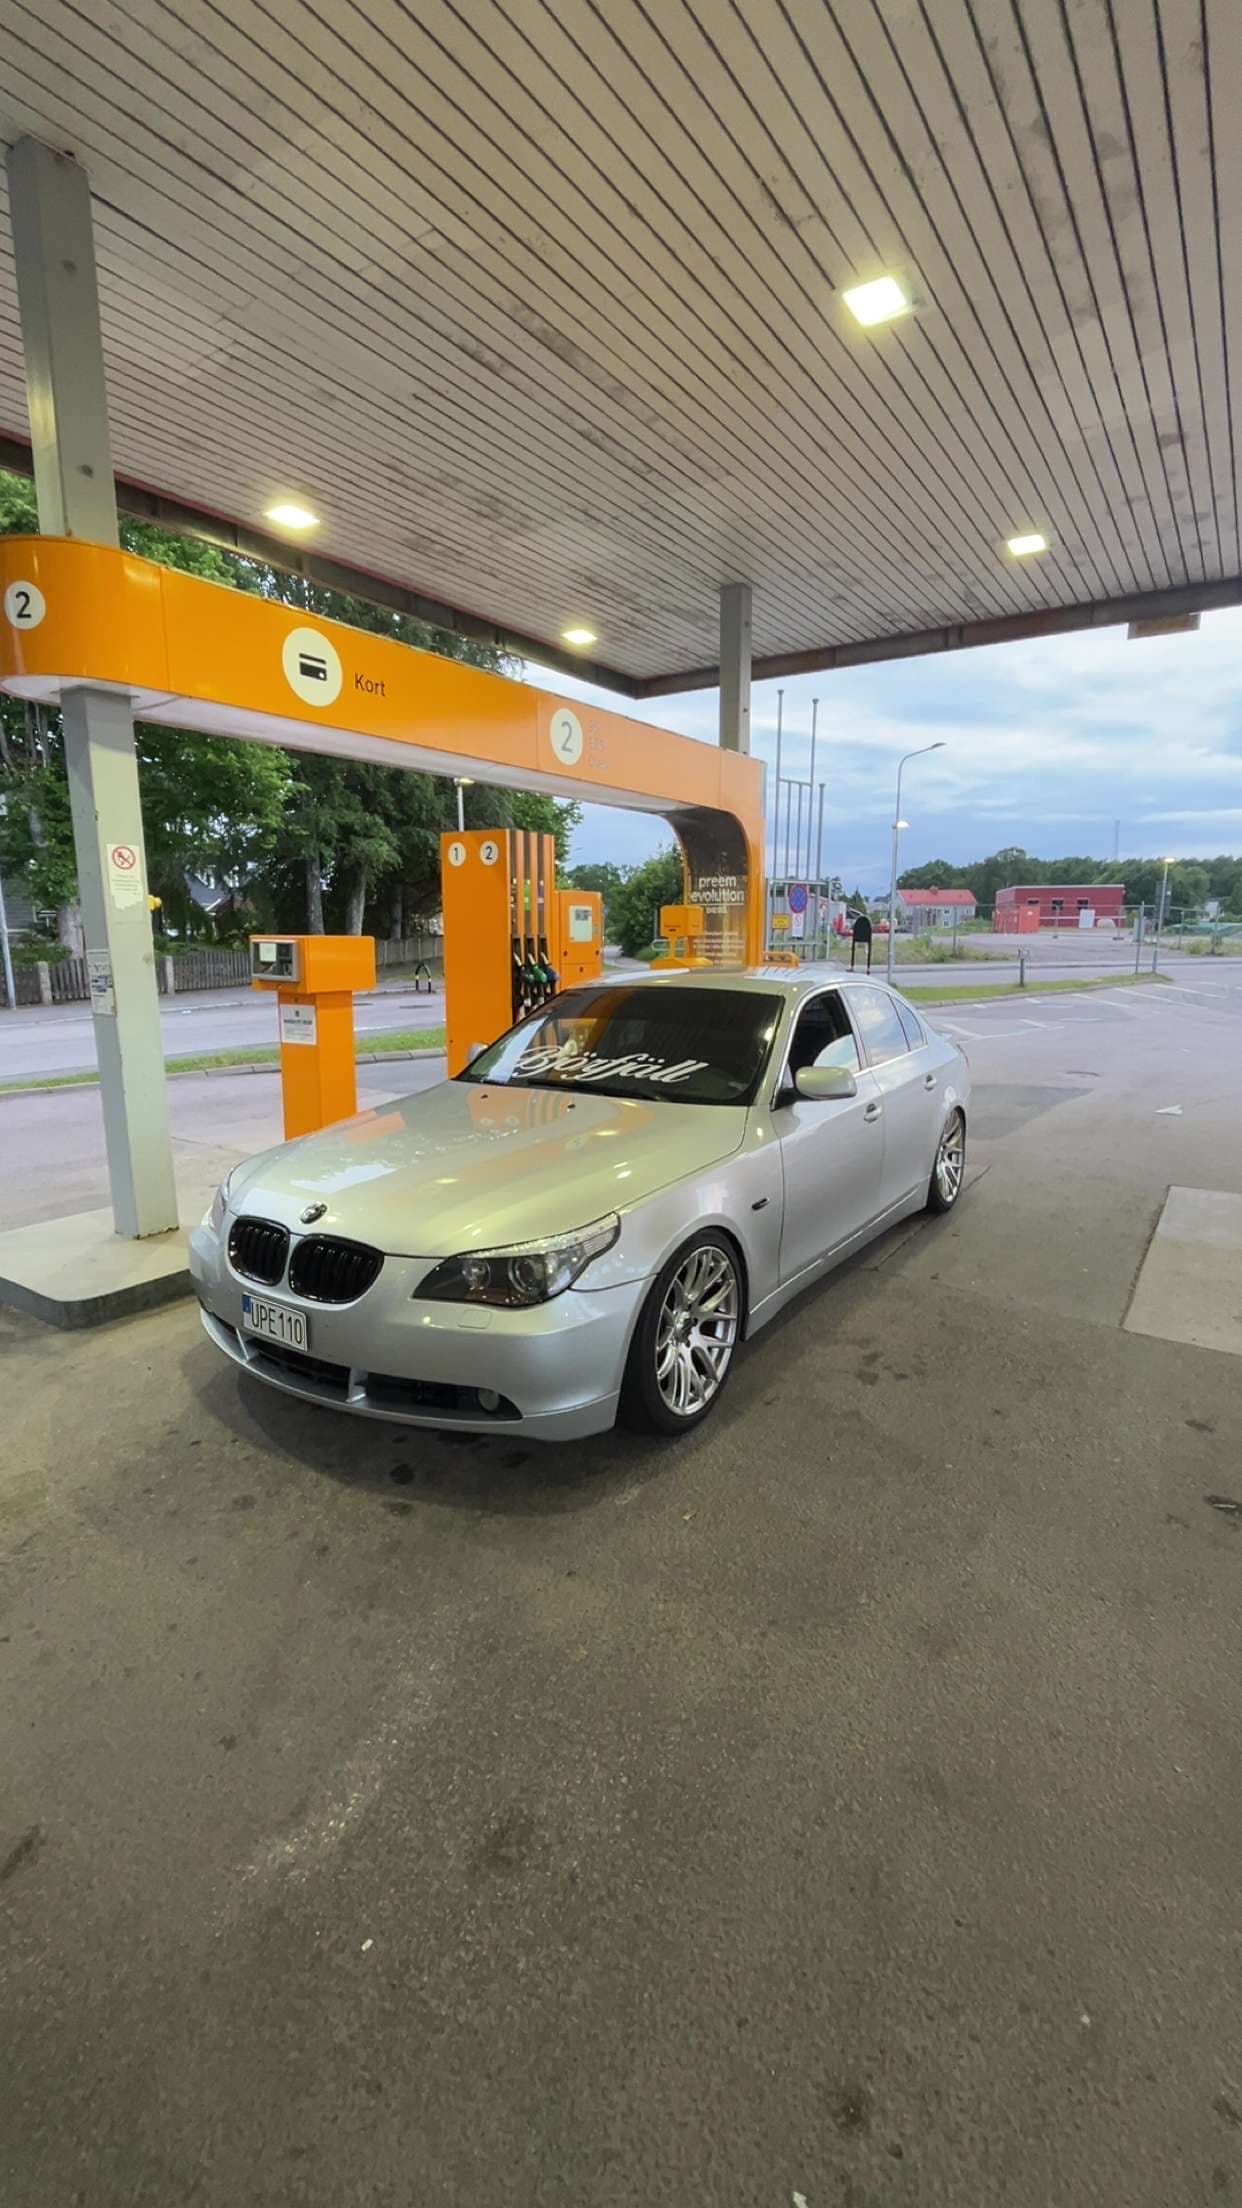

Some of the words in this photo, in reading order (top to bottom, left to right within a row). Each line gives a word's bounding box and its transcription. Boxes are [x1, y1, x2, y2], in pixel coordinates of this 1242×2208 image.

[15, 591, 32, 619] 2
[354, 671, 386, 697] Kort
[560, 720, 574, 753] 2
[485, 845, 493, 860] 2
[698, 873, 737, 890] preem
[690, 888, 745, 903] evolution
[251, 1301, 303, 1345] UPE110
